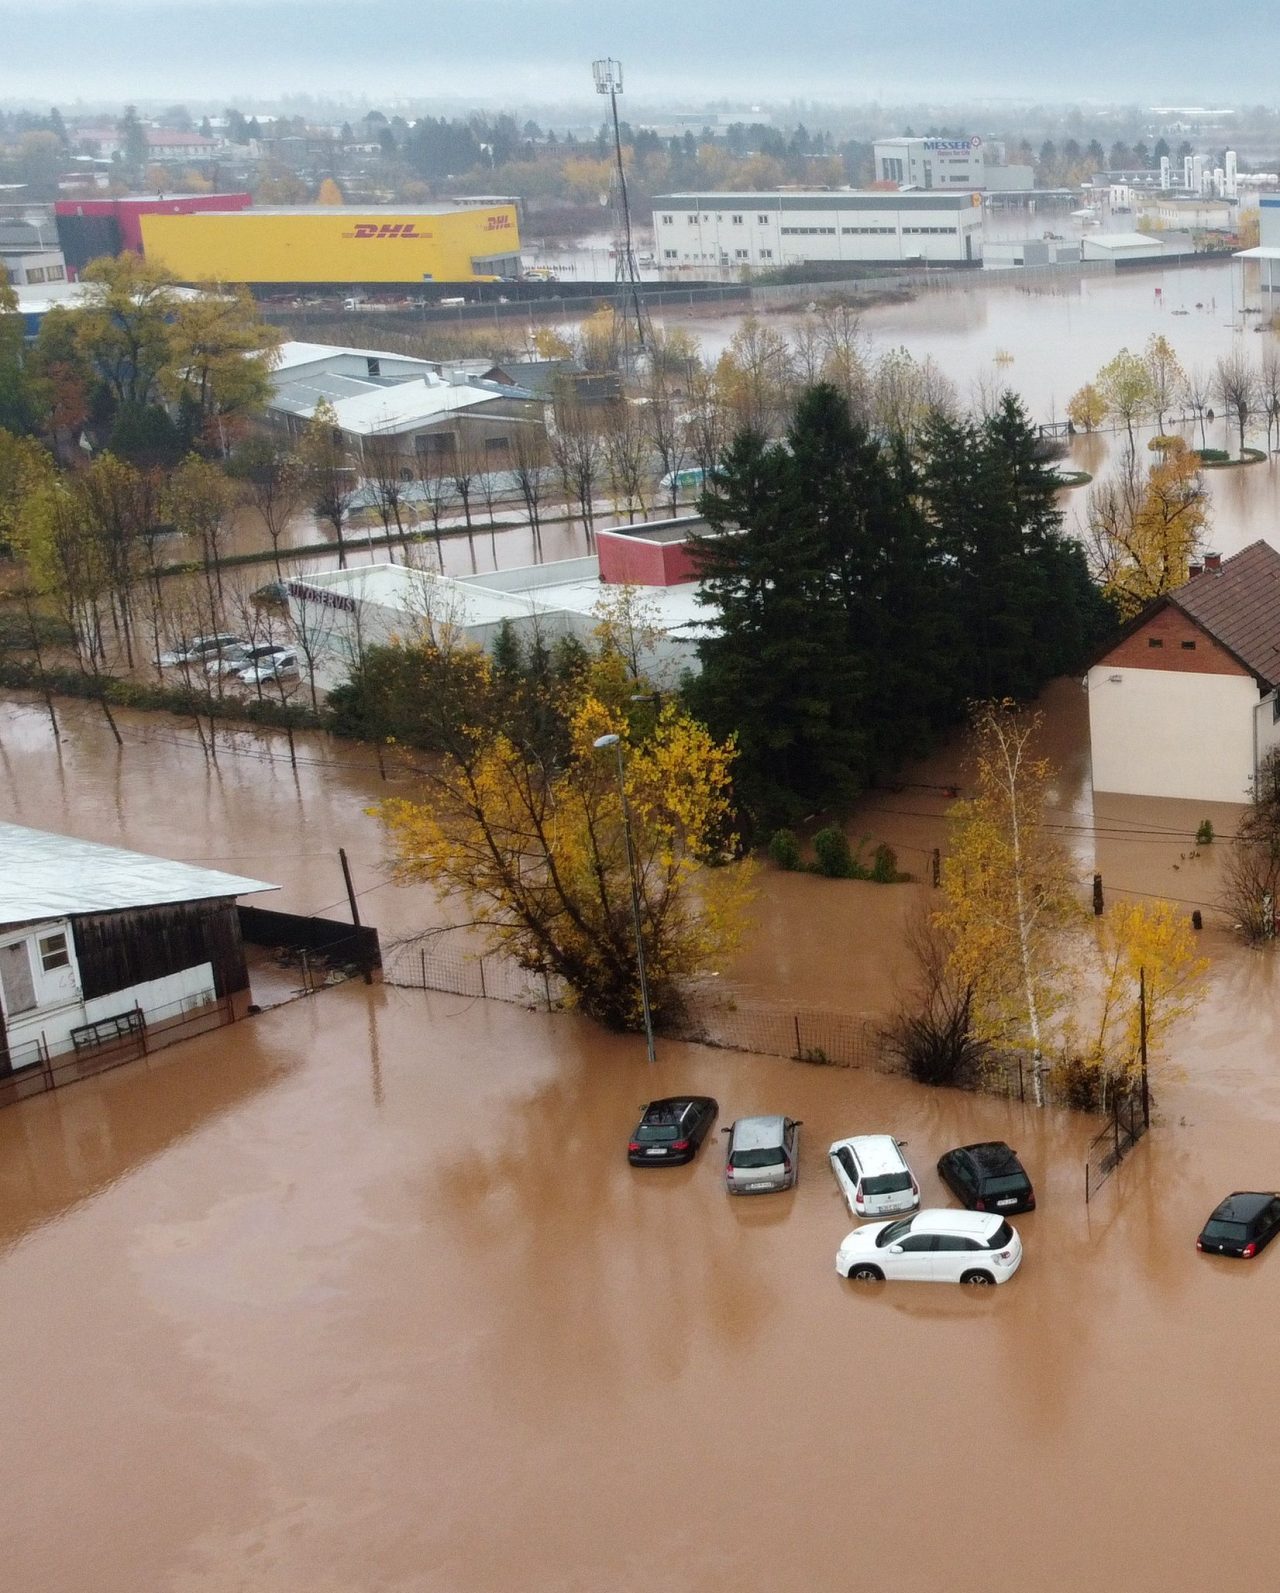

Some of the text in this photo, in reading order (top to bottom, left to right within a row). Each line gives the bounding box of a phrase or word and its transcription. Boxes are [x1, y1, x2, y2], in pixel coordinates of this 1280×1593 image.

[923, 141, 970, 150] MESSER
[487, 215, 512, 231] DHL
[353, 224, 421, 239] DHL
